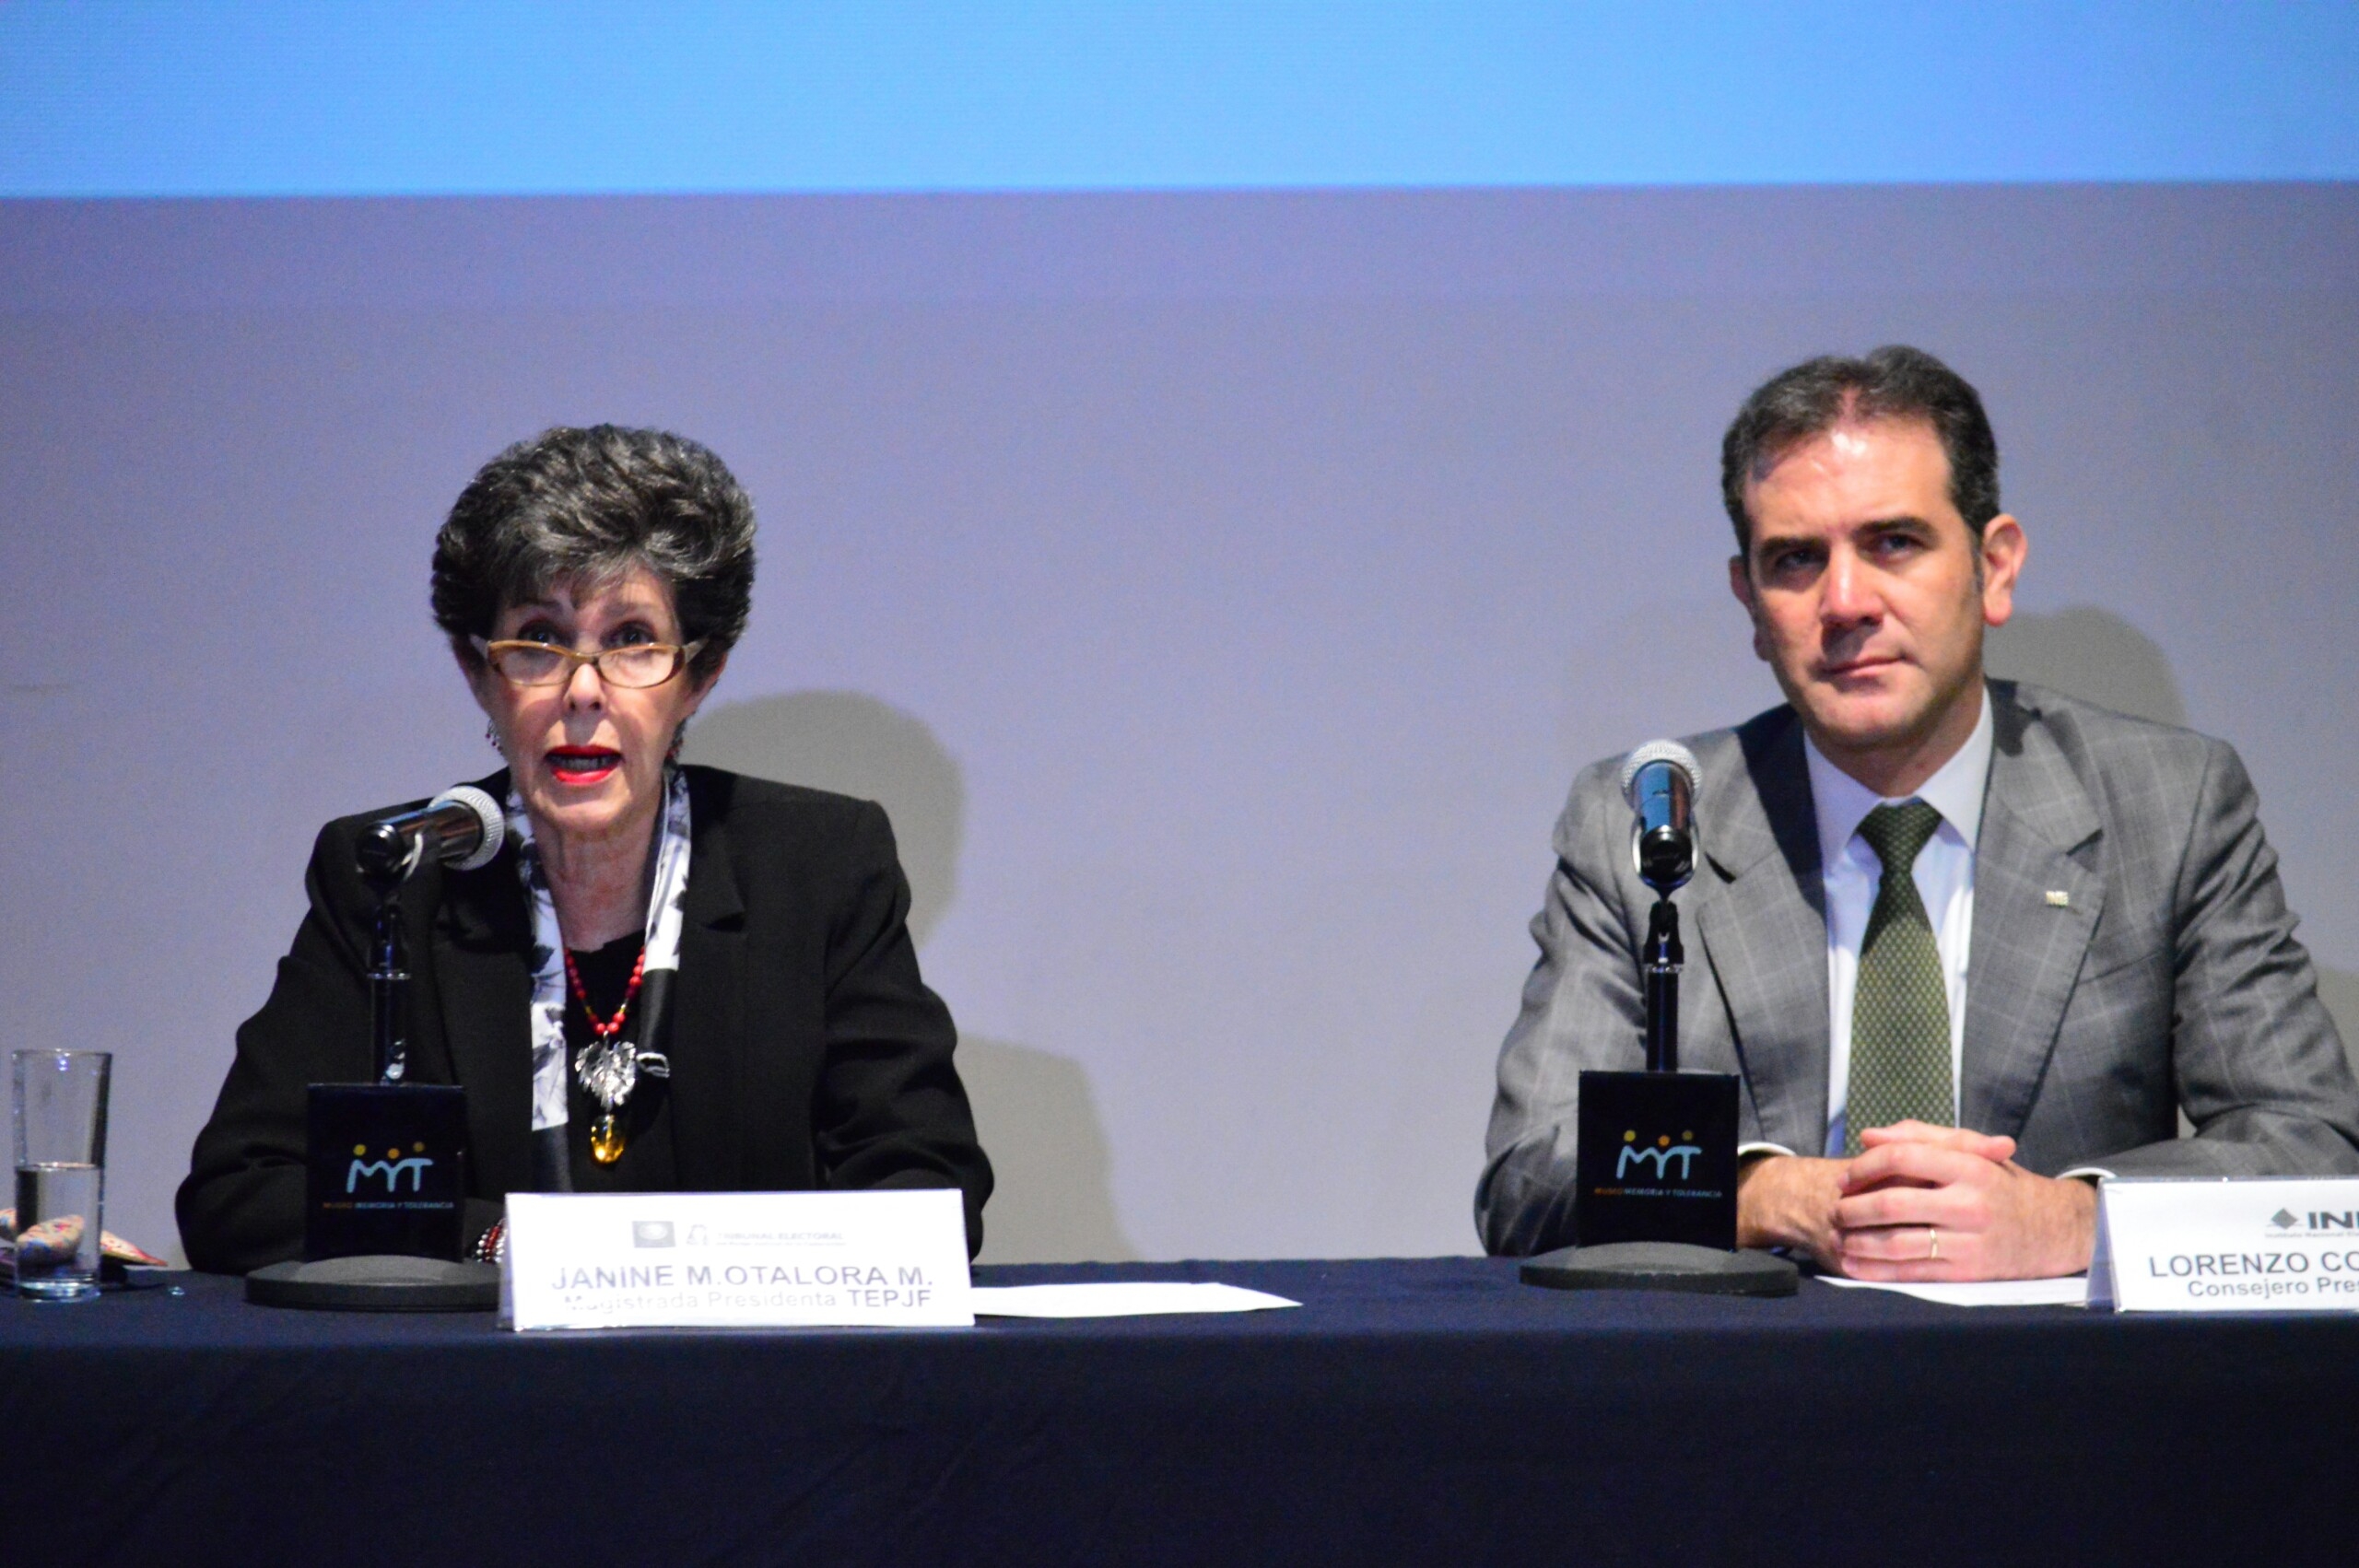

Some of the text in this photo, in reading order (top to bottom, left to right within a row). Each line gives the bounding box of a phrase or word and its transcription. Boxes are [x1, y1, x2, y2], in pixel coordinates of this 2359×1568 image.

[2307, 1210, 2359, 1230] IN
[2148, 1252, 2309, 1278] LORENZO
[552, 1265, 674, 1291] JANINE
[898, 1266, 933, 1287] M.
[2188, 1276, 2359, 1299] Consejero Pre
[708, 1290, 837, 1309] Presidenta
[847, 1289, 932, 1308] TEPJF
